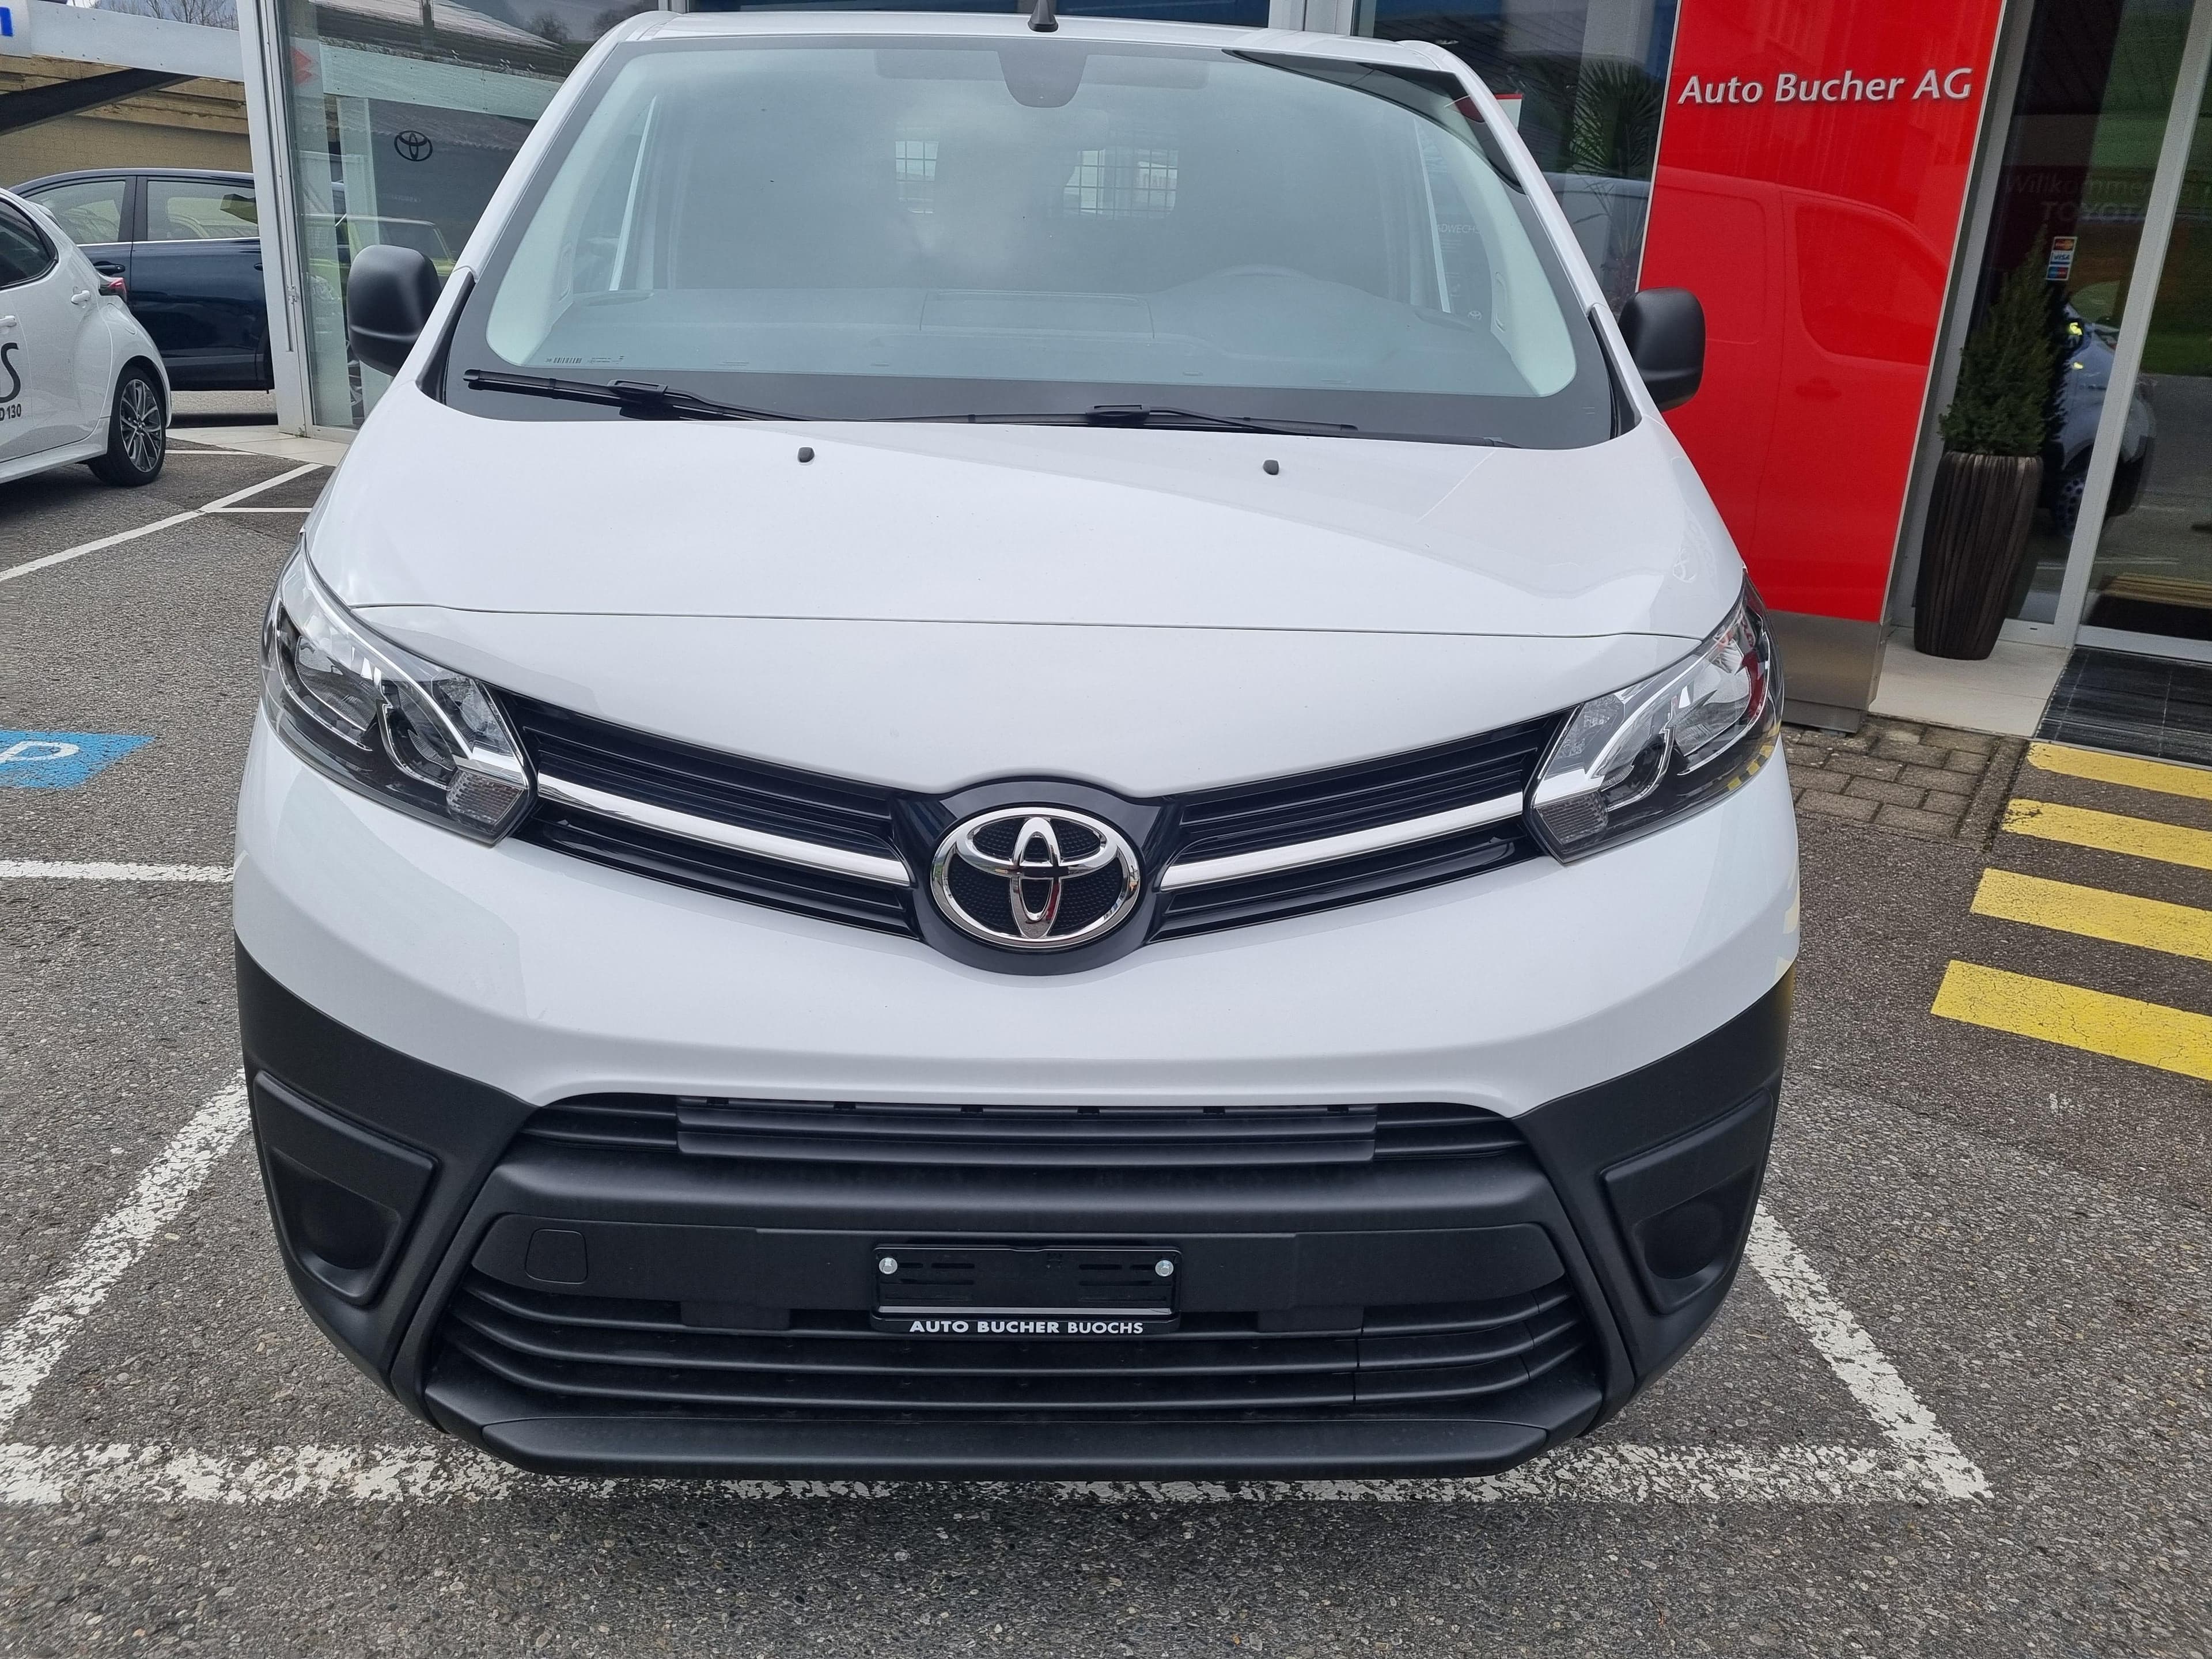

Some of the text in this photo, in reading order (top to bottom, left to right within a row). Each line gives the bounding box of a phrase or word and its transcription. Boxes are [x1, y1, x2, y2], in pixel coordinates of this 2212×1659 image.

[1677, 67, 1972, 104] Auto Bucher AG
[6, 403, 22, 419] 130
[909, 1320, 1143, 1334] AUTO BUCHER BUOCHS
